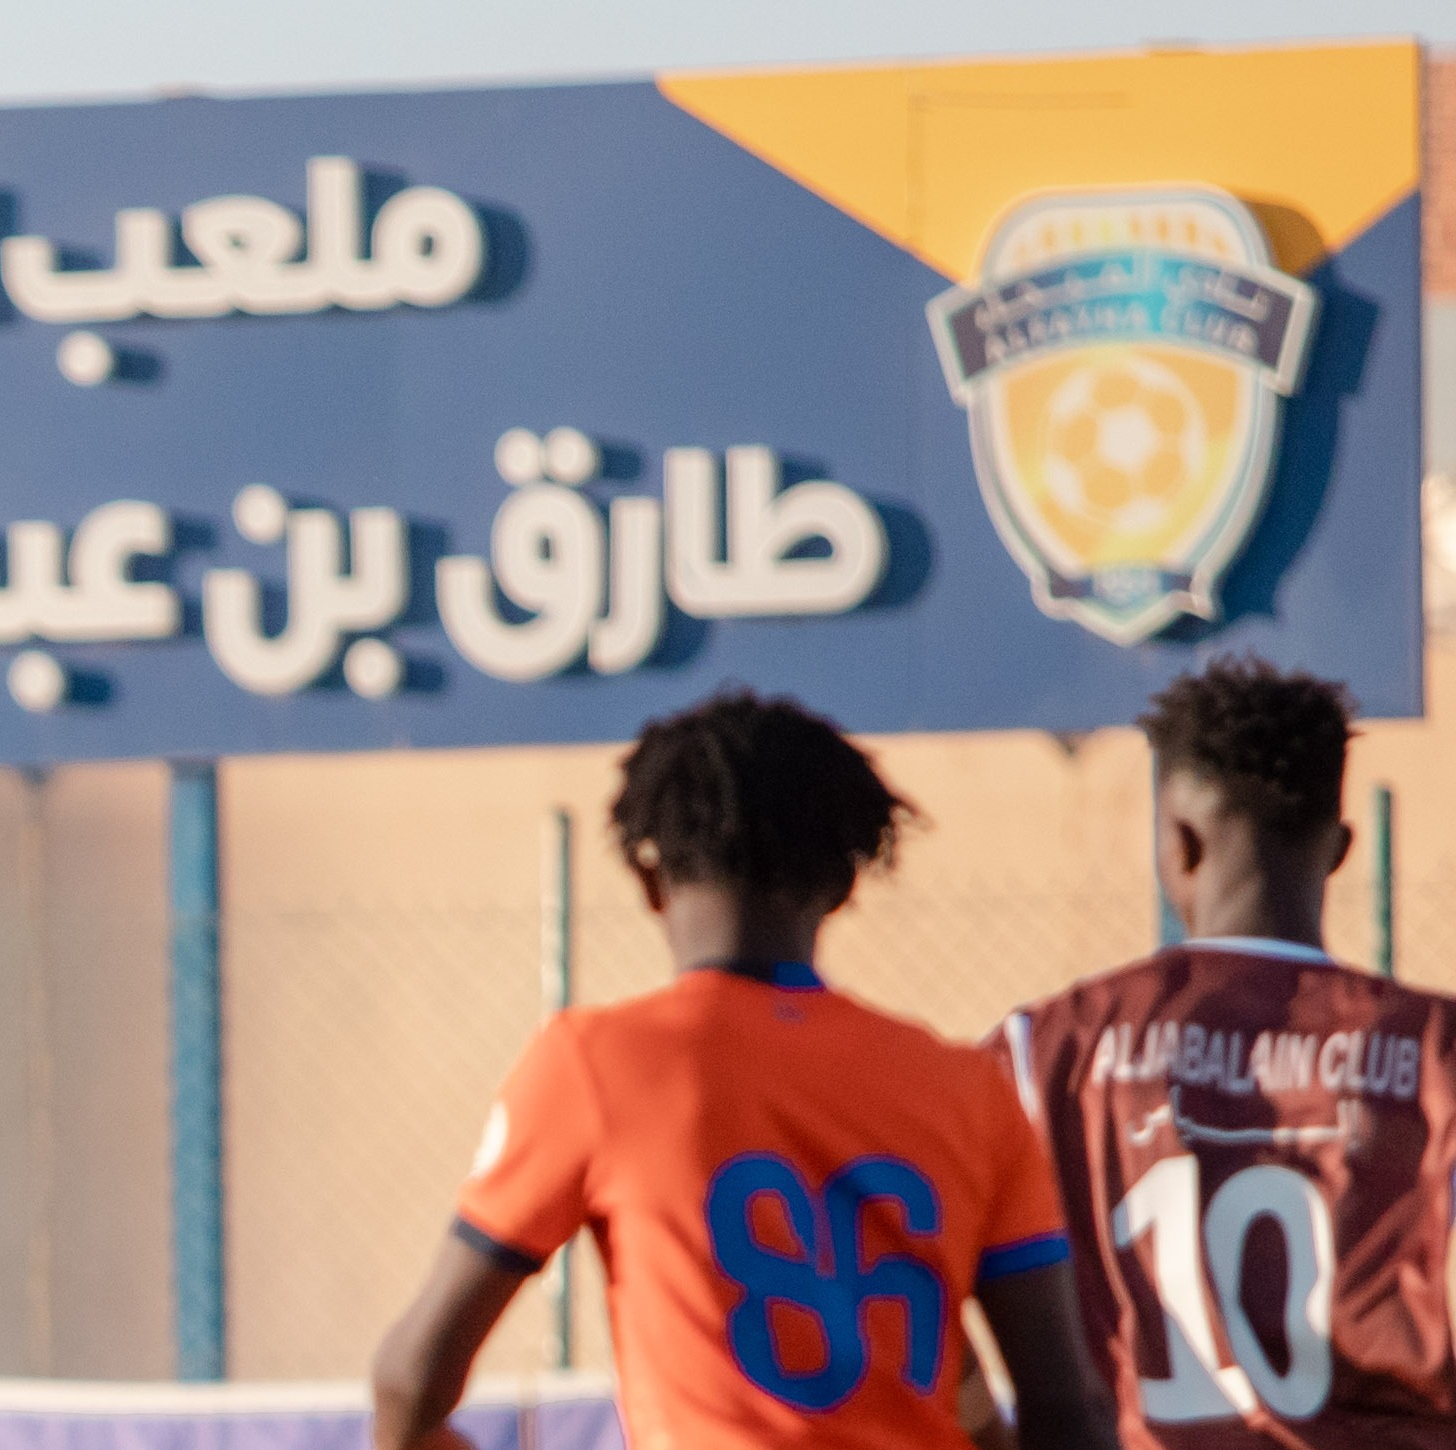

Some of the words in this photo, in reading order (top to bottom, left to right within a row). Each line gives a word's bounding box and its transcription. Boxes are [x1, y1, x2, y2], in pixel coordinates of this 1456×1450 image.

[1, 156, 483, 386] ملعب
[201, 484, 404, 698] بن
[436, 428, 884, 681] طارق
[1318, 1030, 1421, 1098] CLUB
[703, 1149, 945, 1416] 86
[1110, 1153, 1335, 1422] 10
